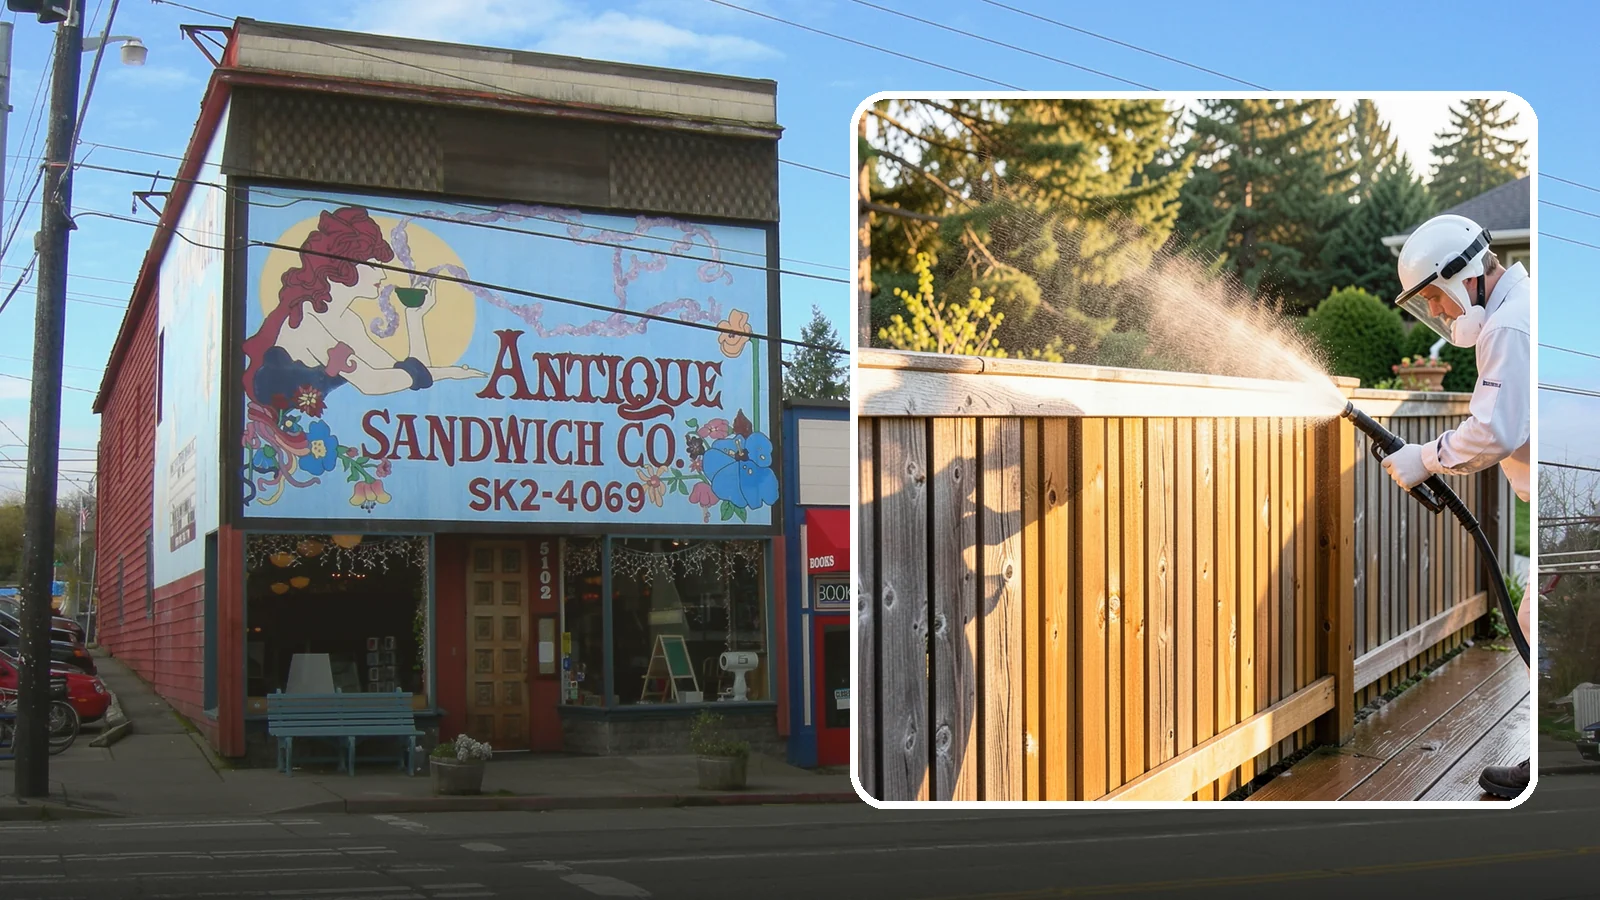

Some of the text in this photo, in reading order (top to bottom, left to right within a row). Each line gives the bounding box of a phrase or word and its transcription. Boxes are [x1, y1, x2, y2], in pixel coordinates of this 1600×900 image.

[476, 329, 724, 421] ANTIQUE
[361, 409, 685, 469] SANDWICH CO.
[468, 477, 646, 513] SK2-4069
[540, 542, 551, 599] 5102
[809, 555, 835, 569] BOOKS
